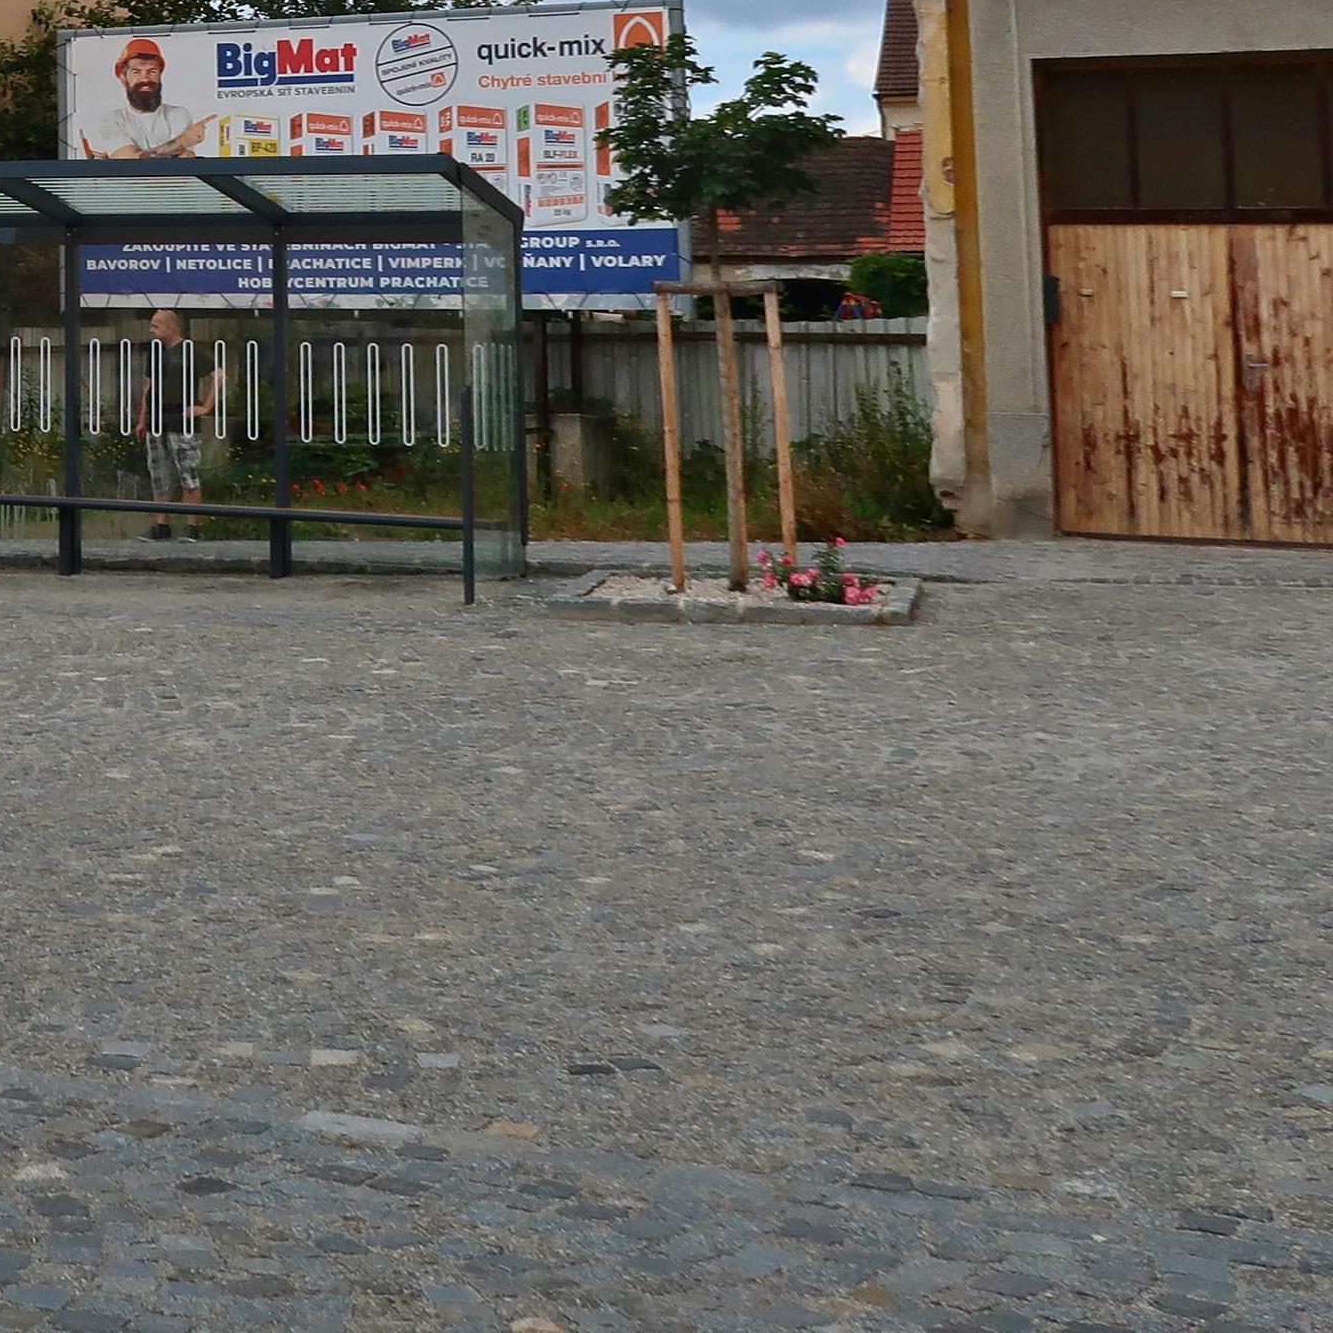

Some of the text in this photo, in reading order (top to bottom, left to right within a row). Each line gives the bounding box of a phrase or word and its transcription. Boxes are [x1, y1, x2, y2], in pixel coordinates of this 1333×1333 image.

[477, 34, 607, 65] quick-mix
[216, 38, 357, 87] BigMat
[478, 72, 533, 90] Chytré
[537, 71, 607, 86] stavební
[86, 258, 161, 271] BAVOROV
[176, 258, 253, 270] NETOLICE
[590, 254, 666, 267] VOLARY
